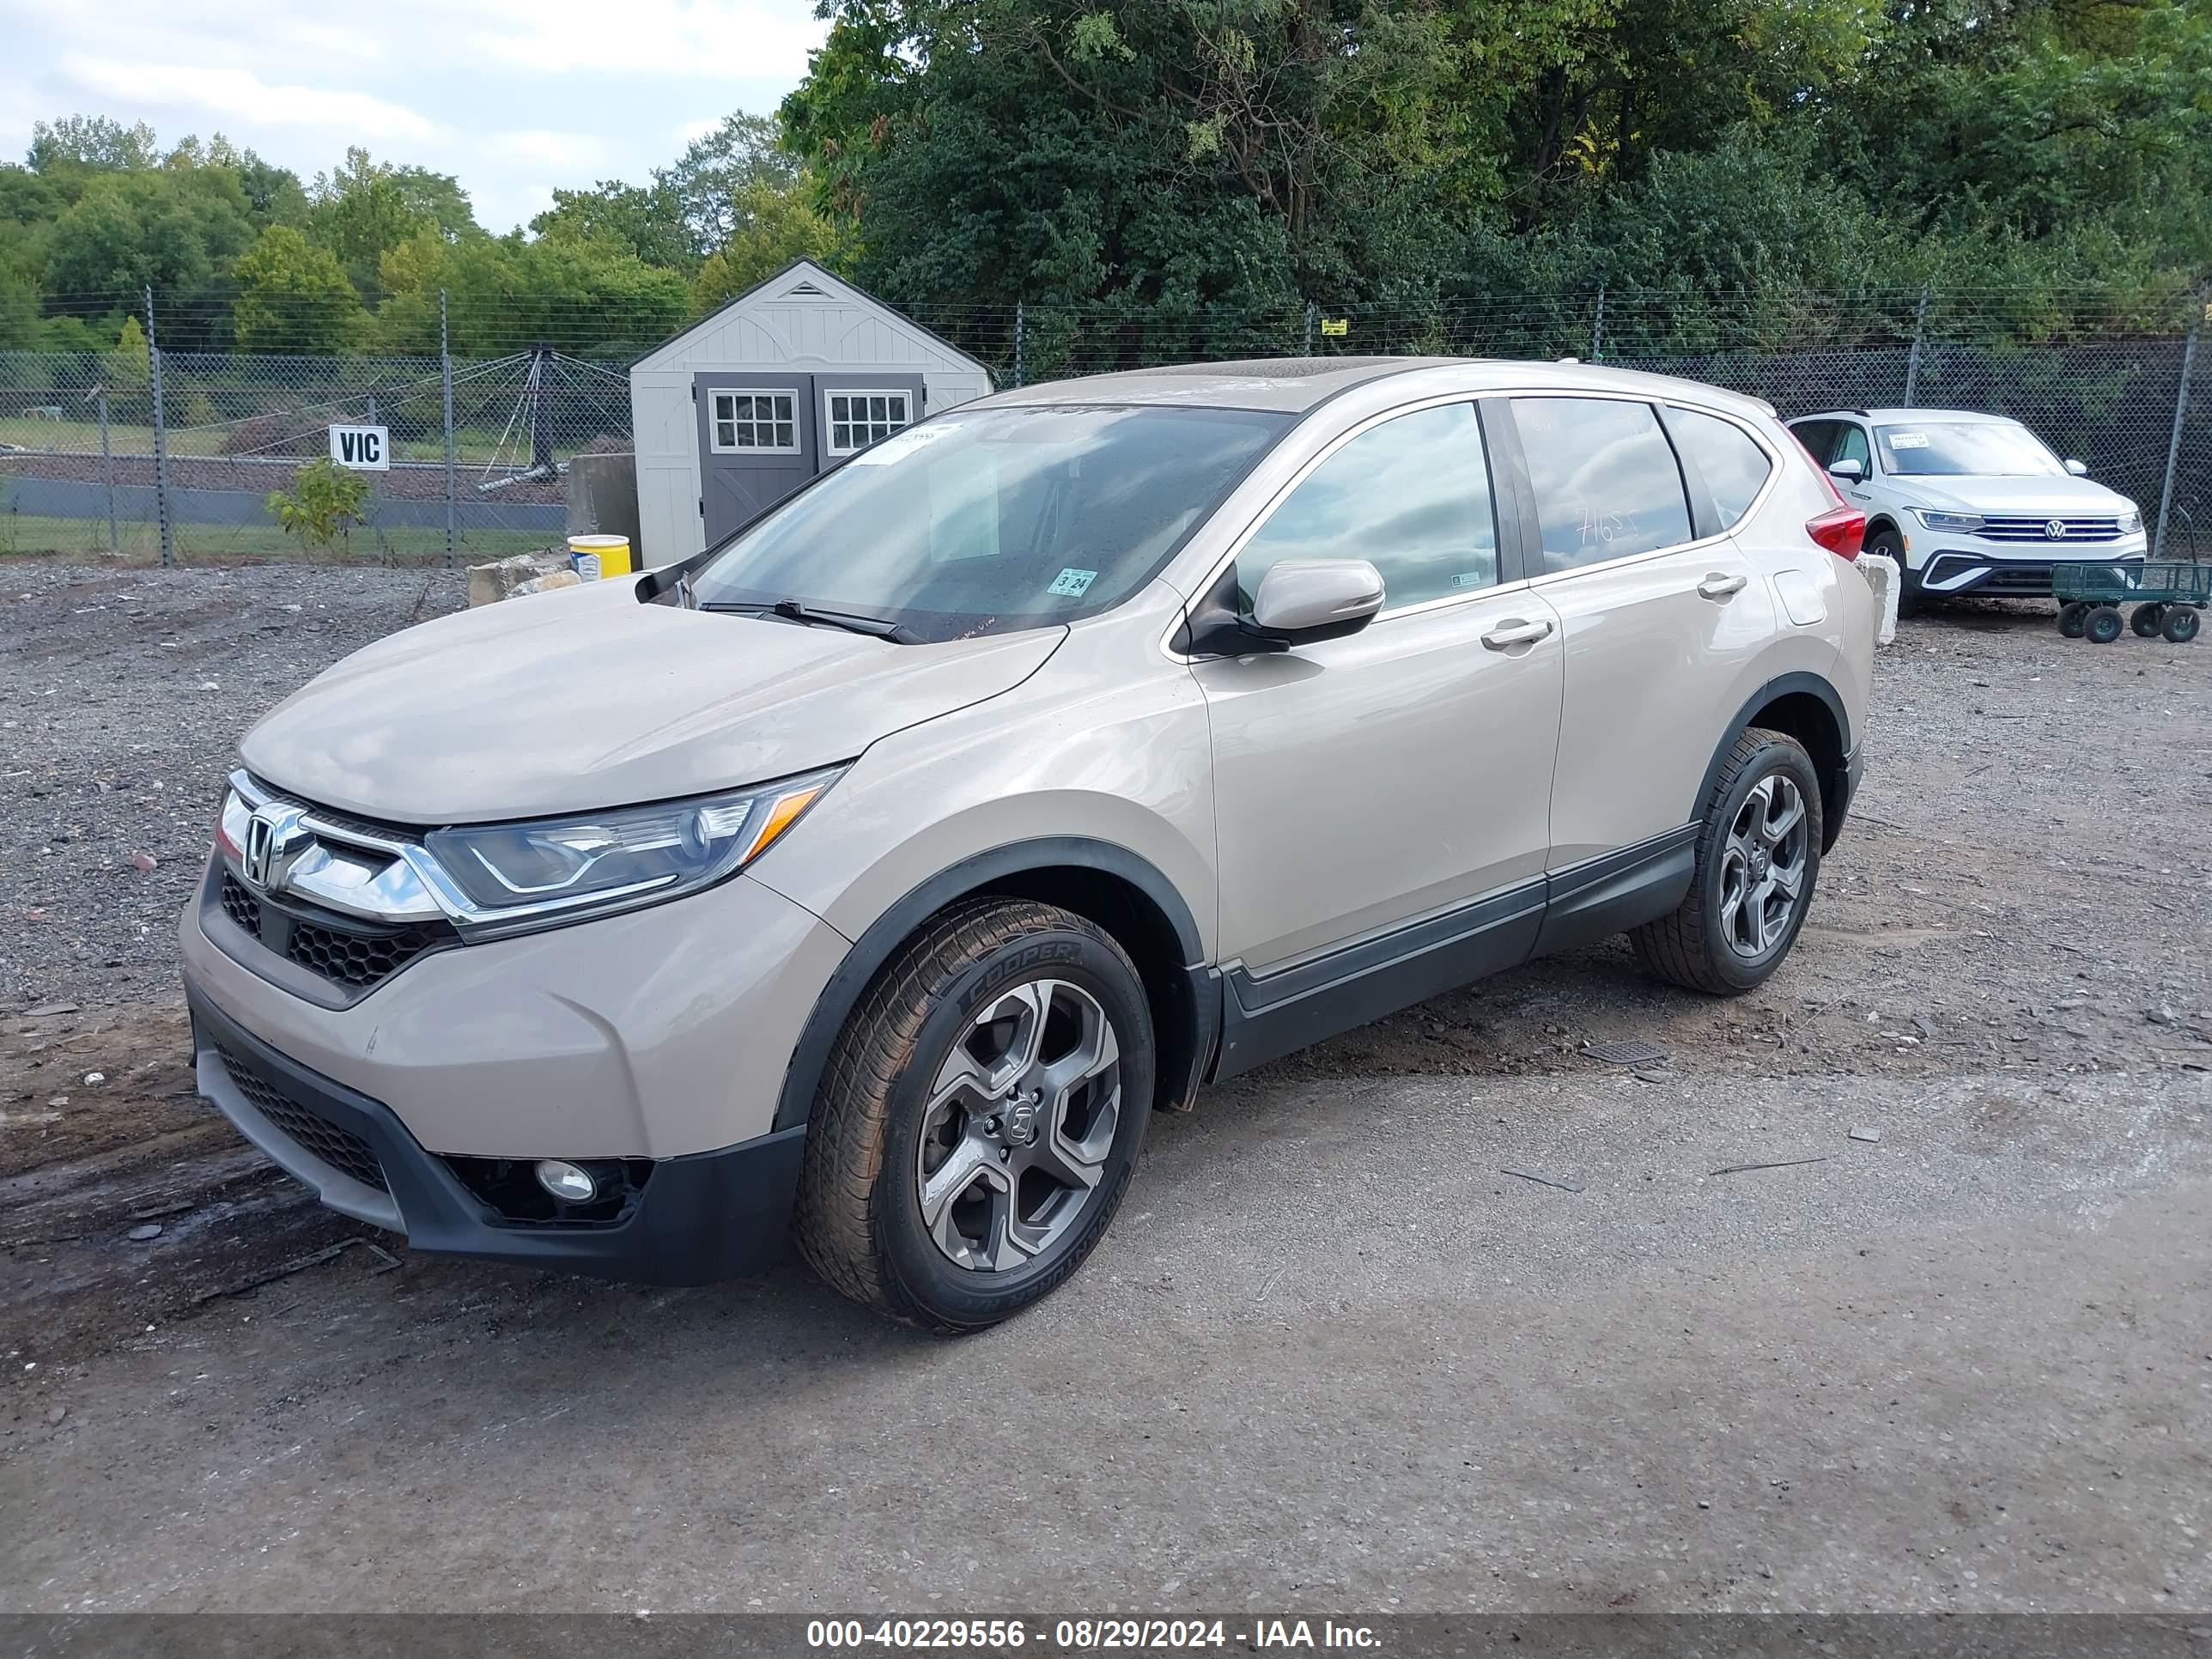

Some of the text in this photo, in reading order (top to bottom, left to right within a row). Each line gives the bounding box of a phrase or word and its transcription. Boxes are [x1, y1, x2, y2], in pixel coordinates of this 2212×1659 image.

[340, 433, 380, 463] VIC
[1058, 576, 1069, 586] 3
[1070, 578, 1087, 589] 24
[970, 944, 1073, 1004] COOPER
